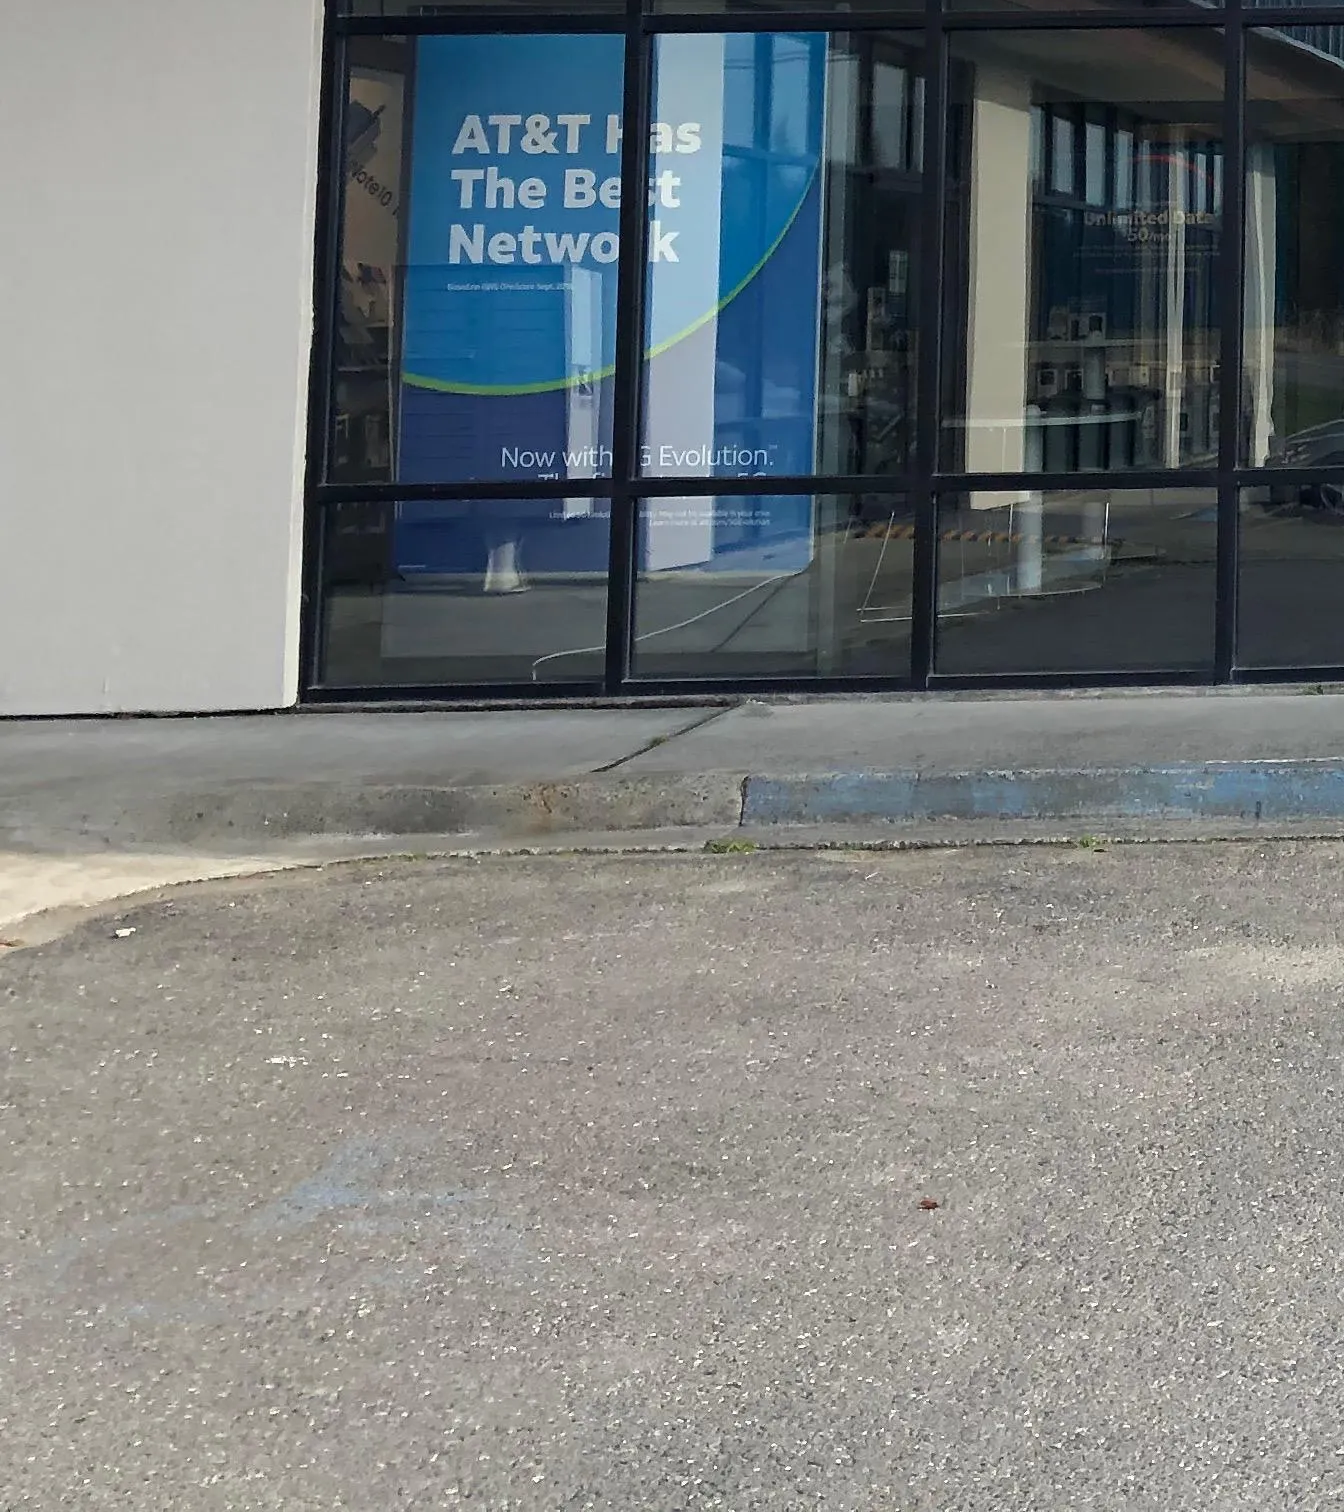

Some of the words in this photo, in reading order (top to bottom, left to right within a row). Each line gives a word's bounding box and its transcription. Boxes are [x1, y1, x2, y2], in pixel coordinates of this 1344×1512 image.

[452, 114, 590, 155] AT&T
[451, 167, 547, 209] The
[449, 221, 680, 264] Netwok
[501, 446, 555, 468] Now
[562, 445, 612, 467] with
